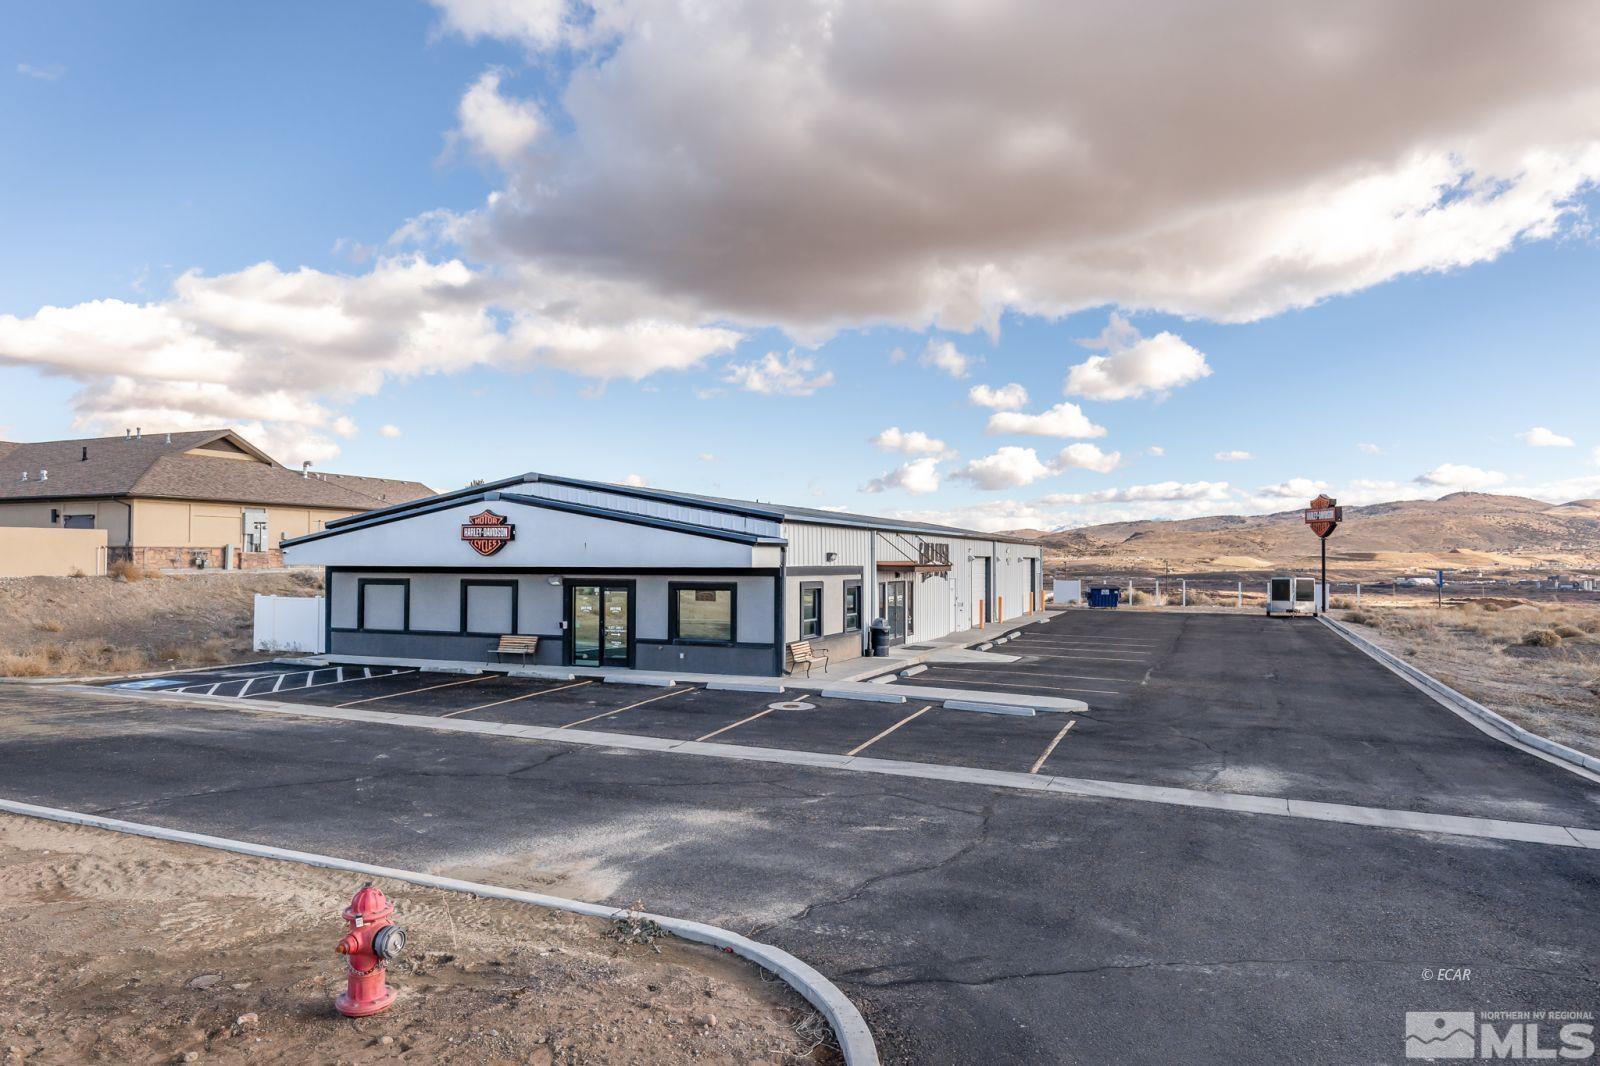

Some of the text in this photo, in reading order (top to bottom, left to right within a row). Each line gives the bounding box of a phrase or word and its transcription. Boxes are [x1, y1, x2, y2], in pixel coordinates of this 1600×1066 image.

[474, 514, 498, 524] MOTOR
[463, 527, 508, 537] HARLEY-DAVIDSON
[474, 540, 497, 552] CYCLES
